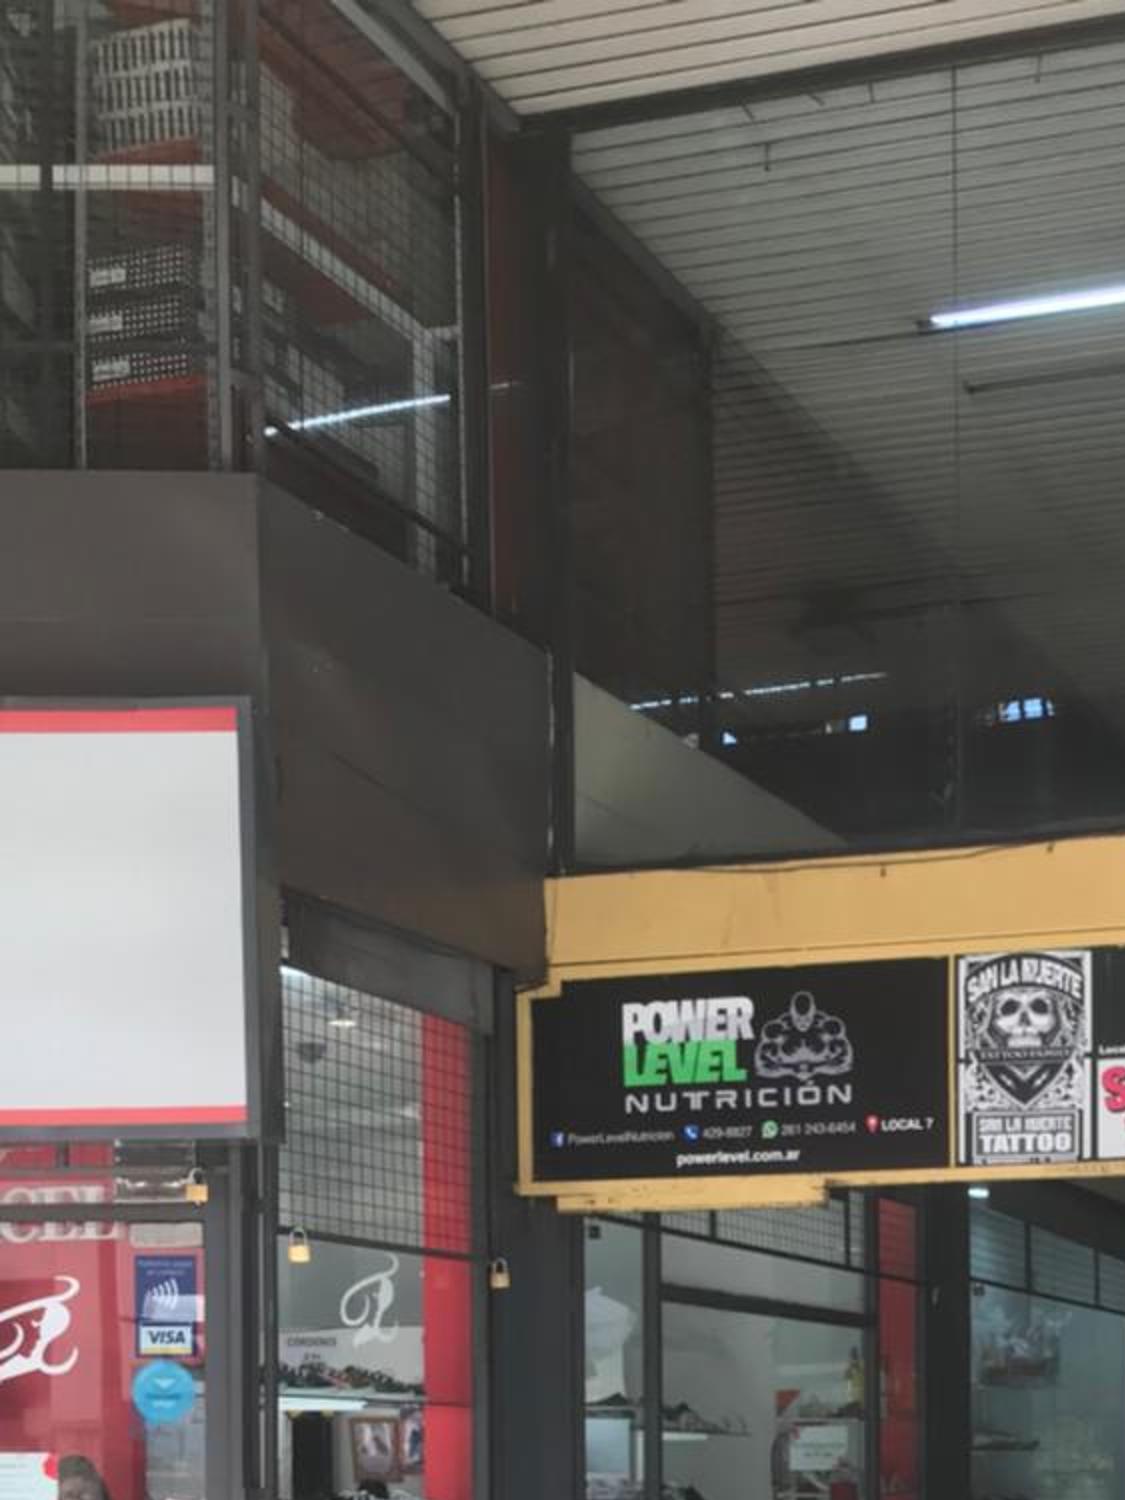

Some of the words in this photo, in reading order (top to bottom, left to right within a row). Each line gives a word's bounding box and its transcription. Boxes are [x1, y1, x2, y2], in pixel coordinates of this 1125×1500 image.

[621, 995, 755, 1047] POWER
[623, 1039, 748, 1088] LEVEL
[624, 1079, 853, 1114] NUTRICIÓN
[880, 1117, 924, 1133] LOCAL
[925, 1117, 935, 1129] 7
[979, 1132, 1073, 1154] TATTOO
[676, 1150, 800, 1168] powerlevel.com.ar
[149, 1330, 186, 1345] VISA
